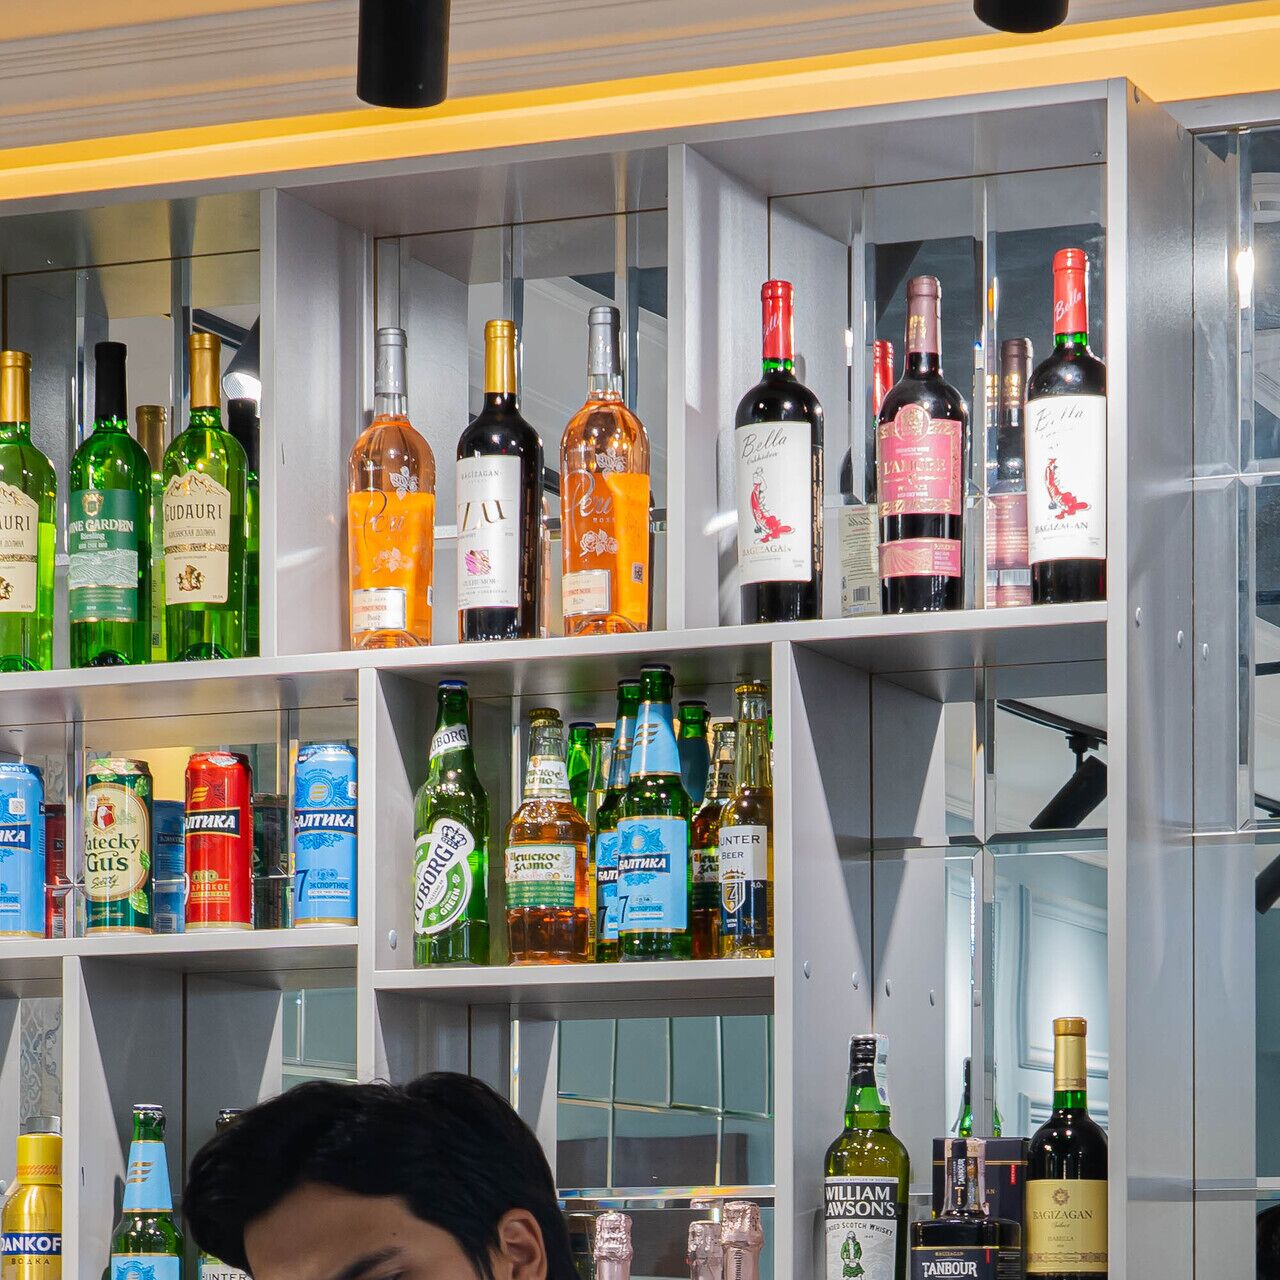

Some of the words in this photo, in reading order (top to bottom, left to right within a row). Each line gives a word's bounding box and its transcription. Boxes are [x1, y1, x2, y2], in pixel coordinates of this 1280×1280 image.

[1055, 287, 1082, 322] Bella
[742, 428, 787, 459] Bella
[165, 504, 222, 522] GUDAURI
[86, 519, 134, 532] GARDEN
[431, 728, 468, 751] UBORG
[185, 814, 236, 829] АЛТИКА
[294, 813, 355, 829] БАЛТИКА
[85, 833, 140, 854] atecký
[720, 835, 761, 847] UNTER
[722, 851, 744, 860] BEER
[619, 857, 667, 871] БАЛТИКА
[598, 870, 618, 882] БАЛТ
[296, 869, 310, 902] 7
[309, 881, 349, 890] ЭКСПОРТНОЕ
[619, 895, 630, 924] 7
[597, 905, 609, 934] 7
[825, 1186, 890, 1201] WILLIAM
[826, 1201, 896, 1218] AWSON'S
[1032, 1210, 1093, 1220] BAGIZAGAN
[842, 1221, 867, 1230] SCOTCH
[869, 1224, 894, 1237] WHISKY
[11, 1257, 50, 1265] ВОДКА
[922, 1261, 978, 1278] TANBOUR
